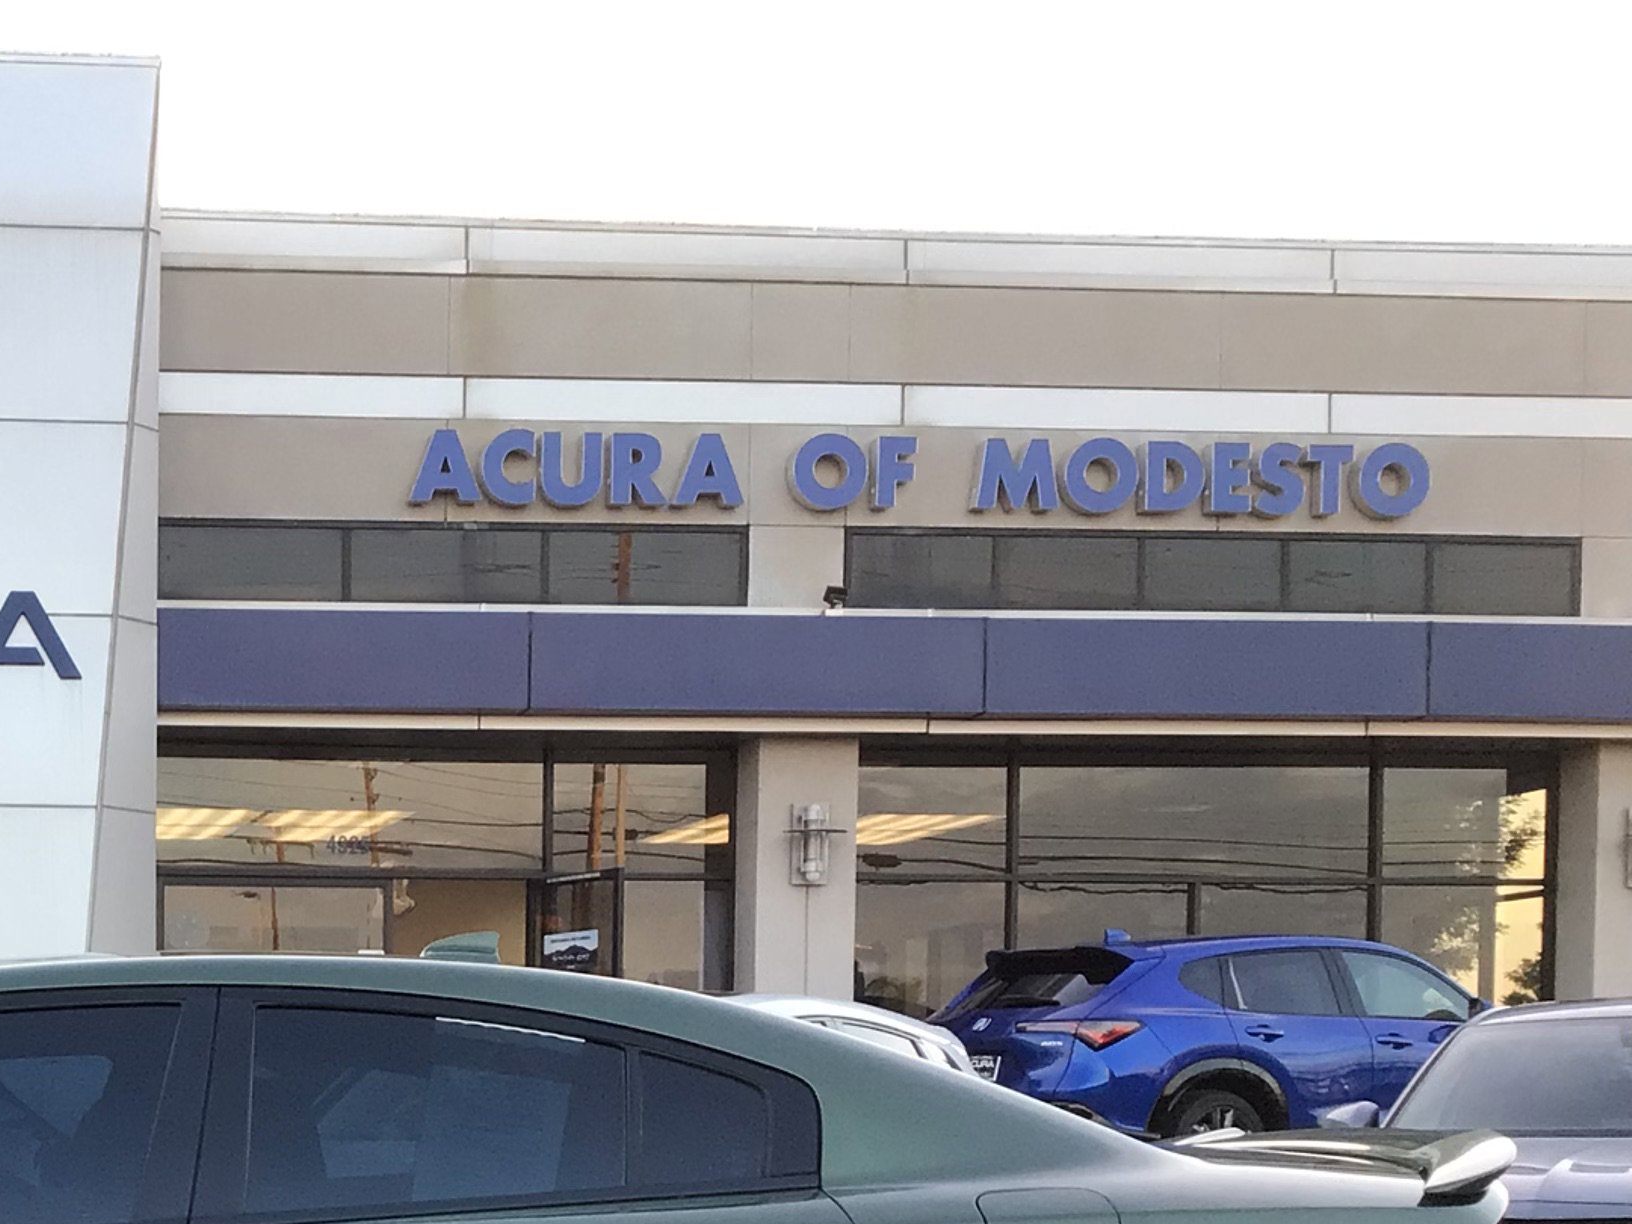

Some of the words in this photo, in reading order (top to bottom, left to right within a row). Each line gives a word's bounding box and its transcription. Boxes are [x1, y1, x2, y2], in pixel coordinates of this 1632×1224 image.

[409, 428, 744, 508] ACURA
[789, 433, 917, 509] OF
[973, 437, 1431, 517] MODESTO
